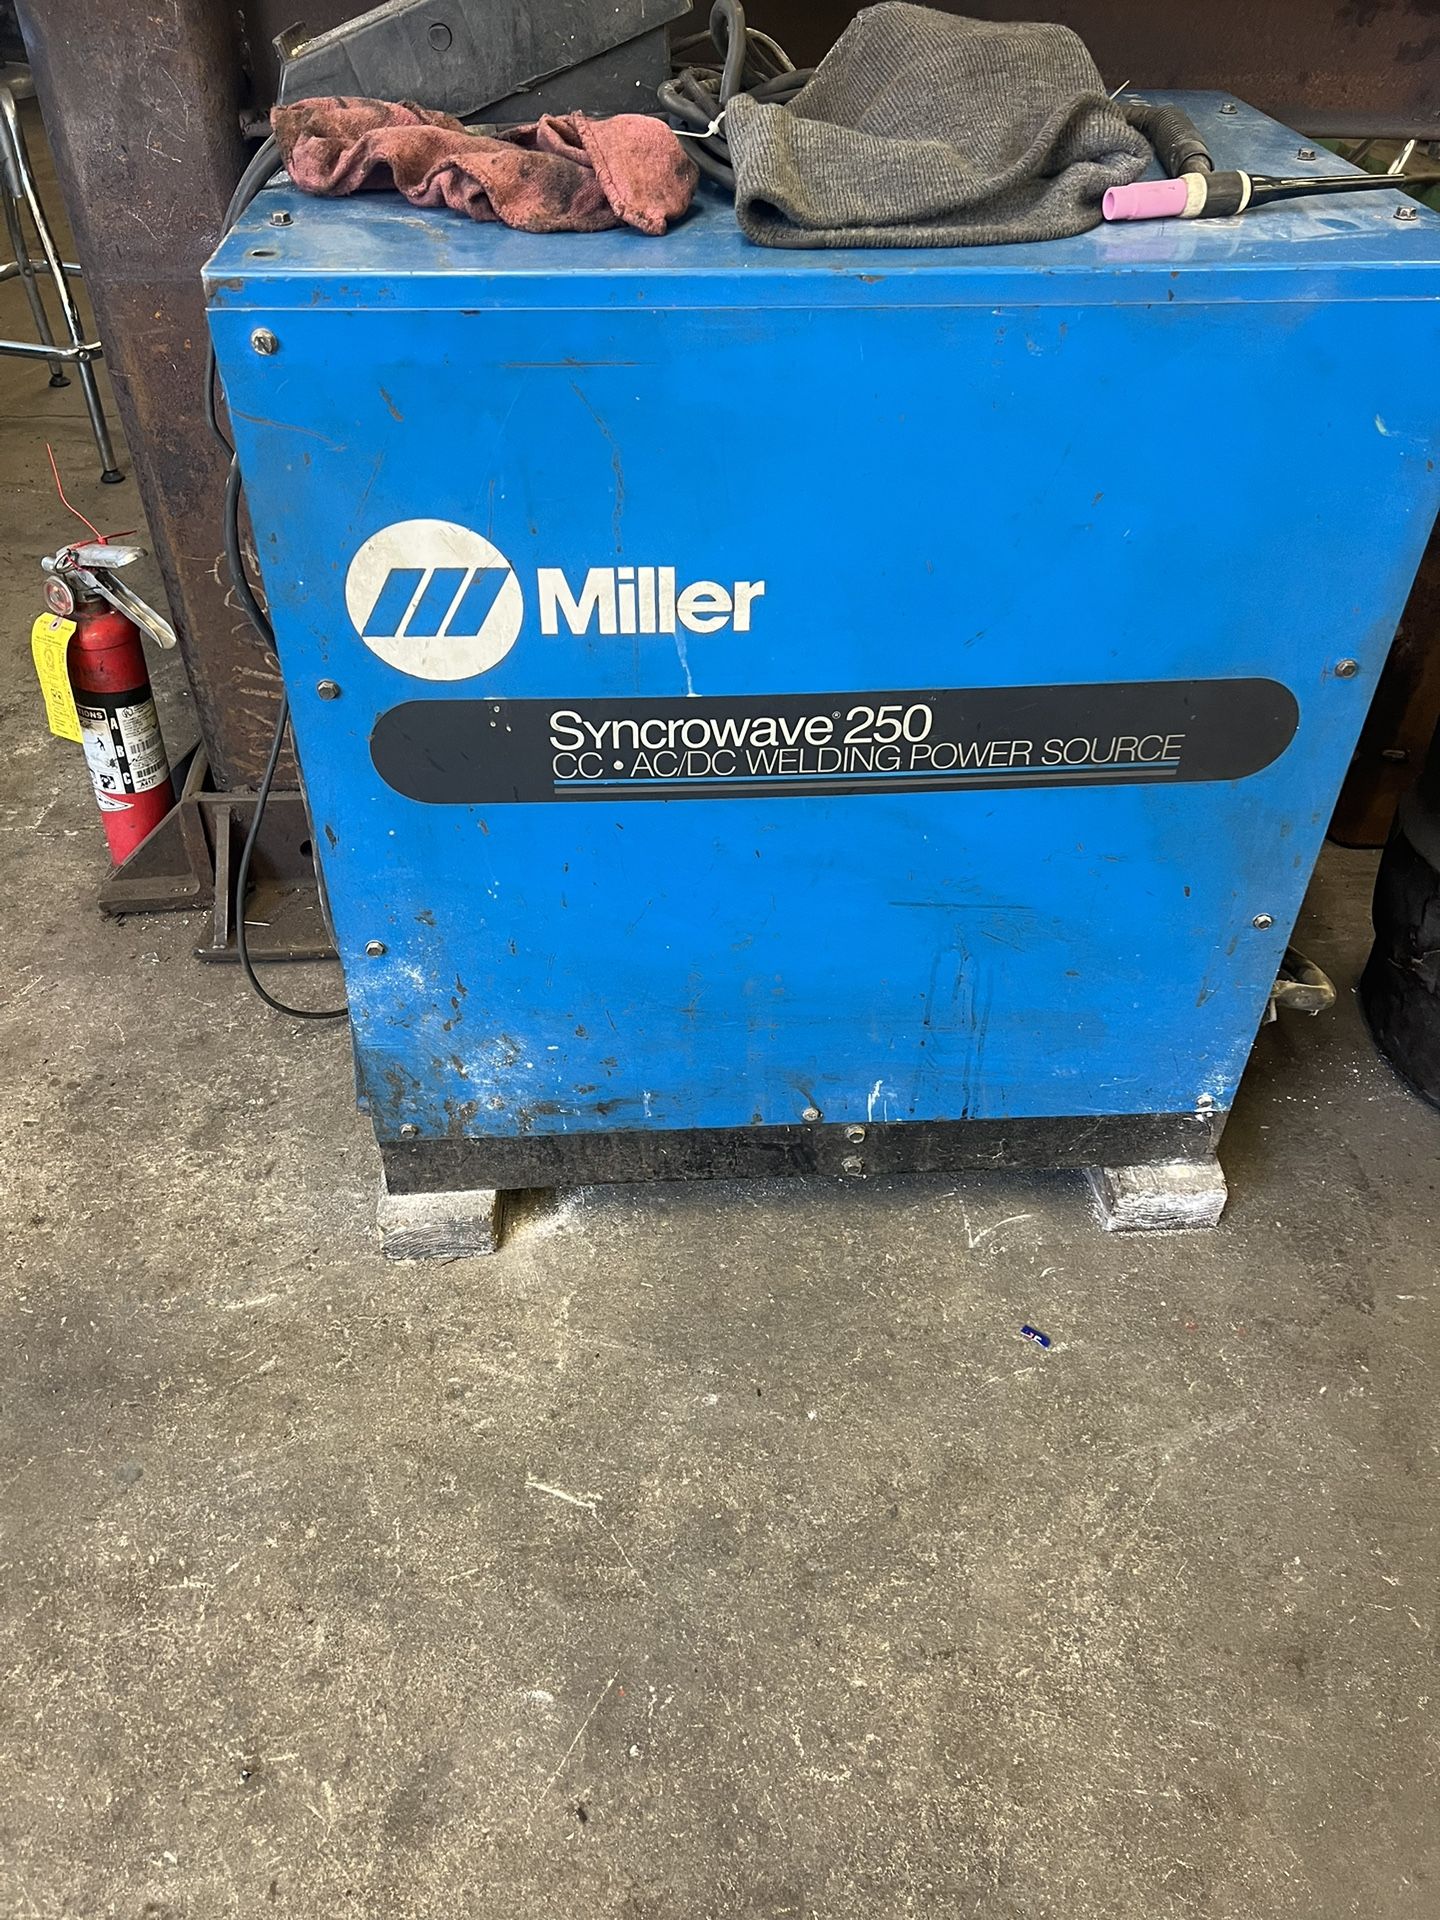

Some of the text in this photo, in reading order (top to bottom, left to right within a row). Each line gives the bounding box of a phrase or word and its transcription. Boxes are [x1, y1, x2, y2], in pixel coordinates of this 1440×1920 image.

[537, 566, 765, 635] Miller
[110, 717, 119, 730] A
[843, 704, 933, 745] 250
[115, 745, 125, 758] B
[552, 752, 604, 779] CC
[630, 750, 737, 777] AC/DC
[746, 745, 901, 775] WELDING
[910, 741, 1033, 770] POWER
[1041, 734, 1186, 766] SOURCE
[122, 772, 132, 785] C
